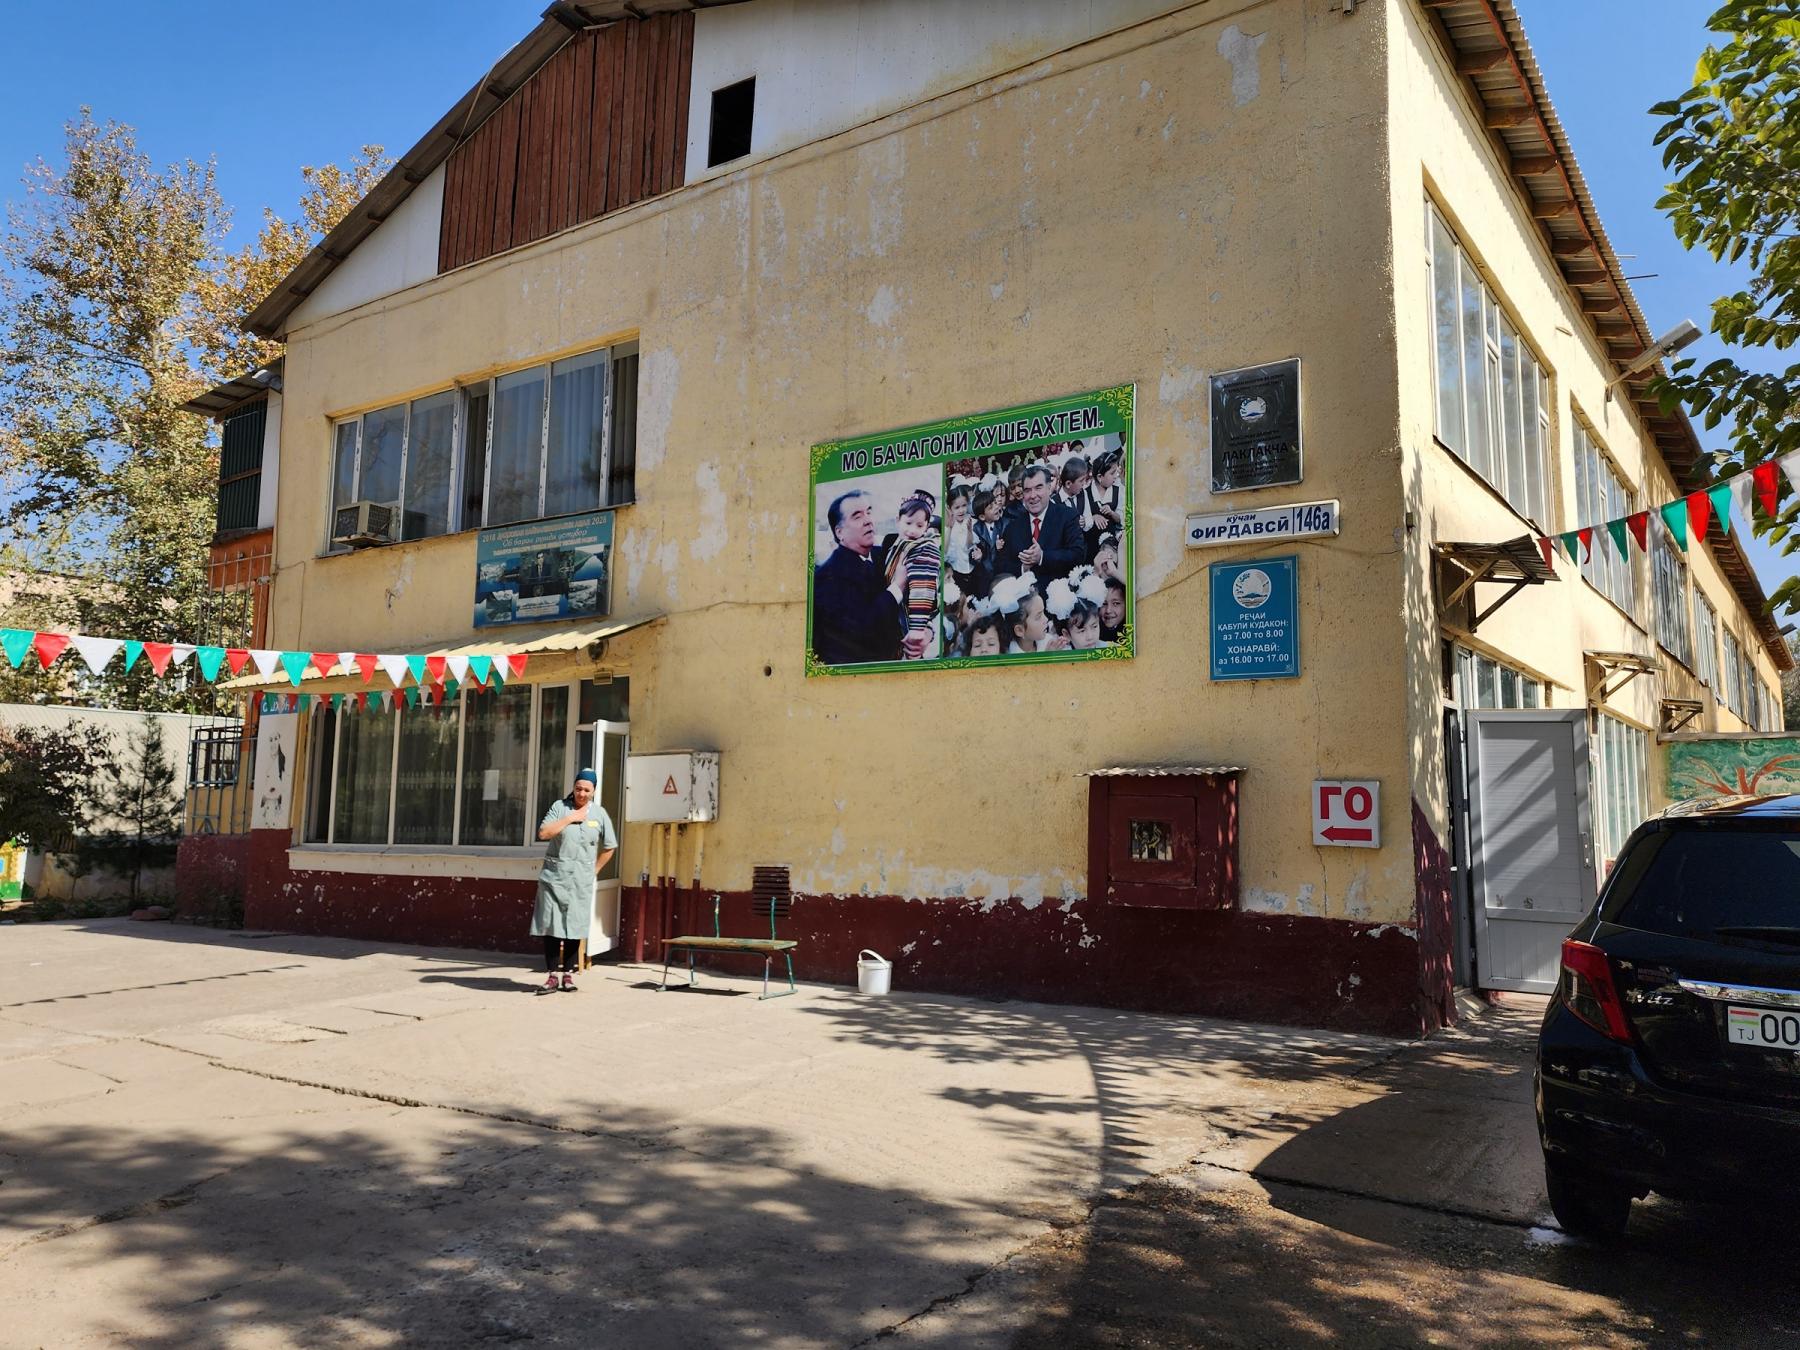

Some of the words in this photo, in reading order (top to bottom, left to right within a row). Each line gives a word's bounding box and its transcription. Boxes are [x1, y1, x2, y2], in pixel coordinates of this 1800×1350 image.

[841, 449, 868, 473] МО
[872, 430, 968, 466] БАЧАГОНИ
[973, 406, 1105, 448] ХУШБАХТЕМ.
[1222, 442, 1288, 462] ЛАКЛАКЧА
[1191, 517, 1289, 540] ФИРДАВСӢ
[1296, 506, 1330, 531] 146а
[1234, 631, 1252, 639] 7.00
[1266, 629, 1283, 637] 8.00
[1230, 655, 1252, 663] 16.00
[1267, 653, 1289, 662] 17.00
[1320, 786, 1372, 821] ГО
[1738, 1028, 1755, 1041] TJ
